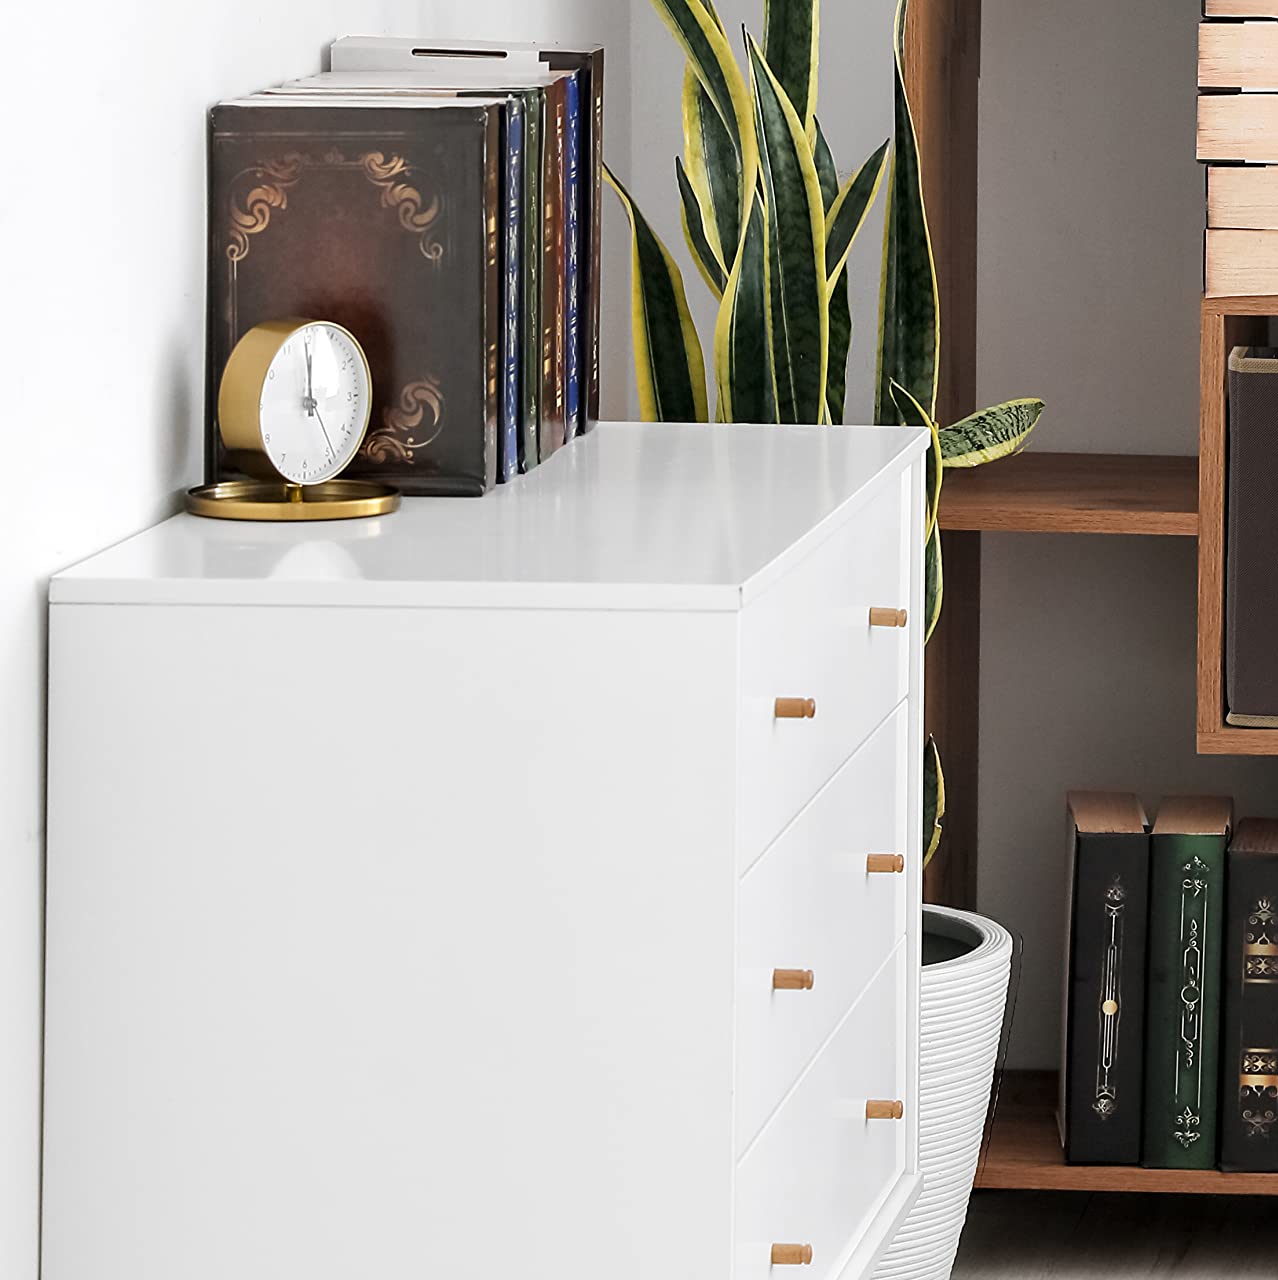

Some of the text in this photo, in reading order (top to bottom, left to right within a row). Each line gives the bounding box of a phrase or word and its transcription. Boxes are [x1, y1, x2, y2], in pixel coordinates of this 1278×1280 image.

[342, 360, 347, 370] 2
[347, 392, 352, 402] 3
[341, 423, 346, 432] 4
[265, 433, 270, 444] 8
[325, 447, 330, 457] 5
[281, 453, 286, 463] 7
[303, 459, 308, 469] 6
